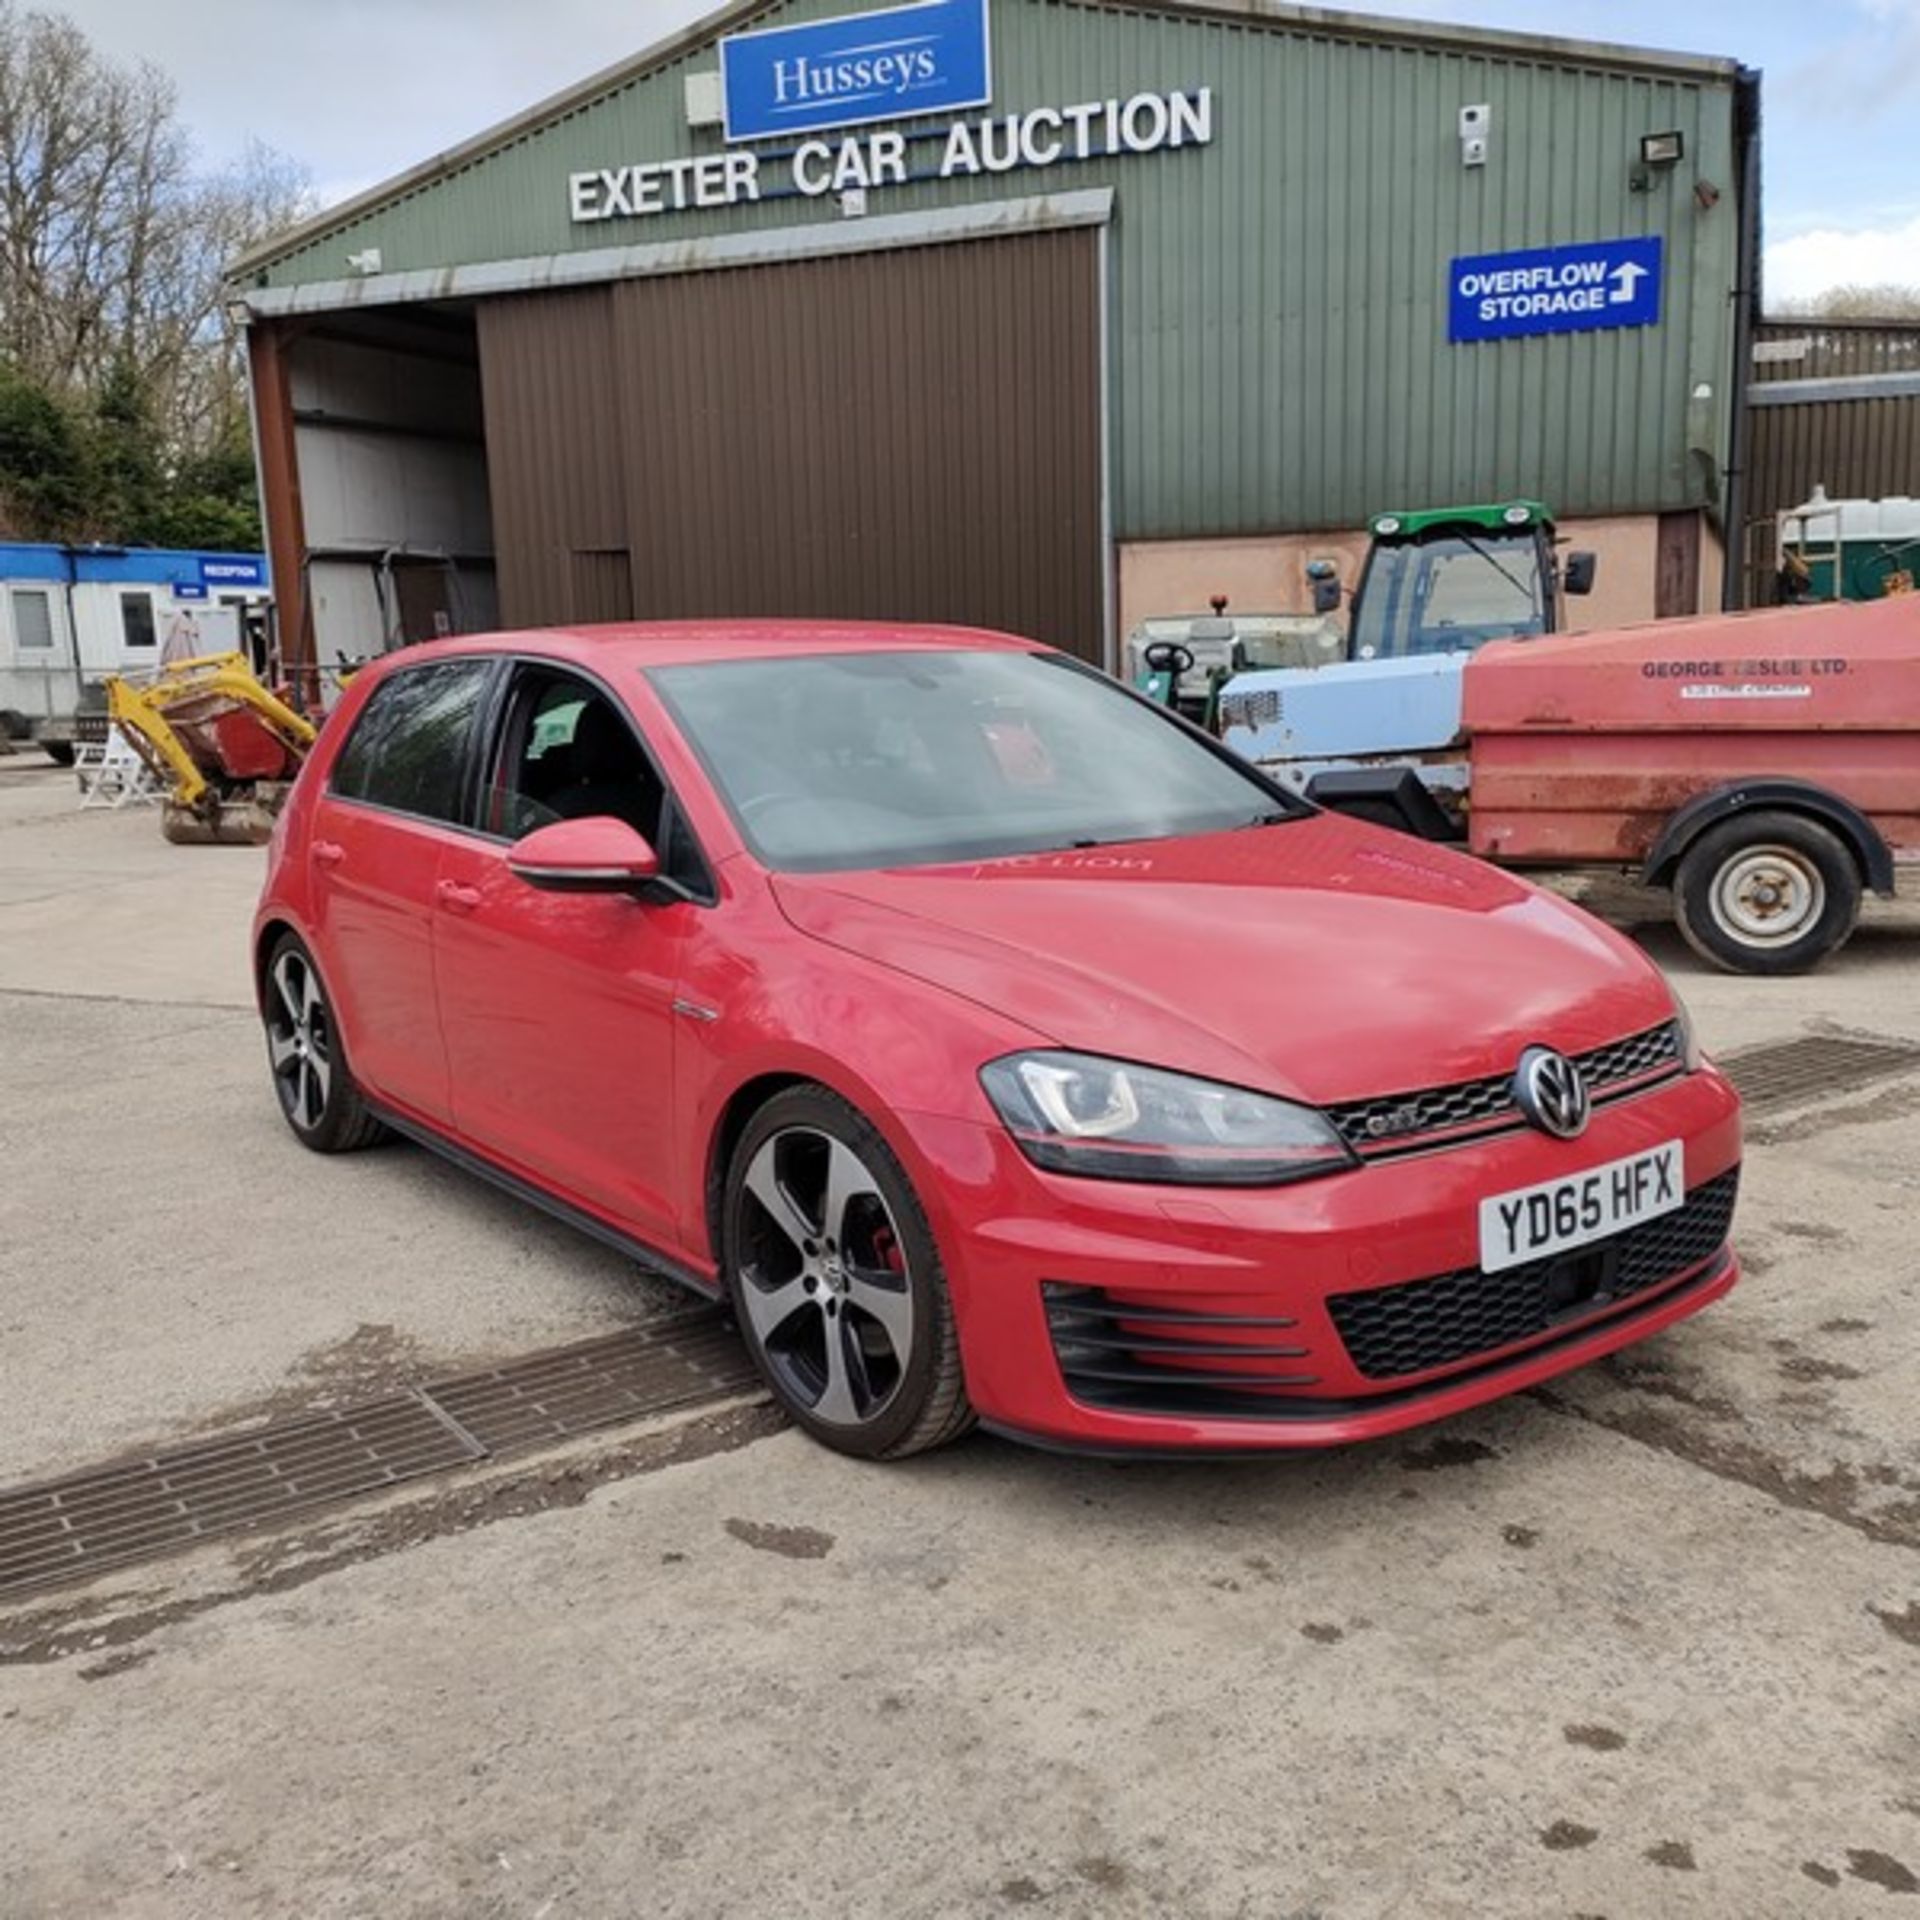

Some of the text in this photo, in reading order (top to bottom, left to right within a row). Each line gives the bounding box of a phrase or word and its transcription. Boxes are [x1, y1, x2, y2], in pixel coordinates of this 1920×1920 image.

[773, 48, 935, 103] Husseys
[569, 87, 1211, 222] EXETER CAR AUCTION
[1459, 261, 1607, 321] OVERFLOW STORAGE
[204, 564, 257, 577] RECEPTION
[1641, 661, 1724, 678] GEORGE
[1810, 657, 1854, 676] LTD.
[1499, 1150, 1674, 1255] YD65 HFX
